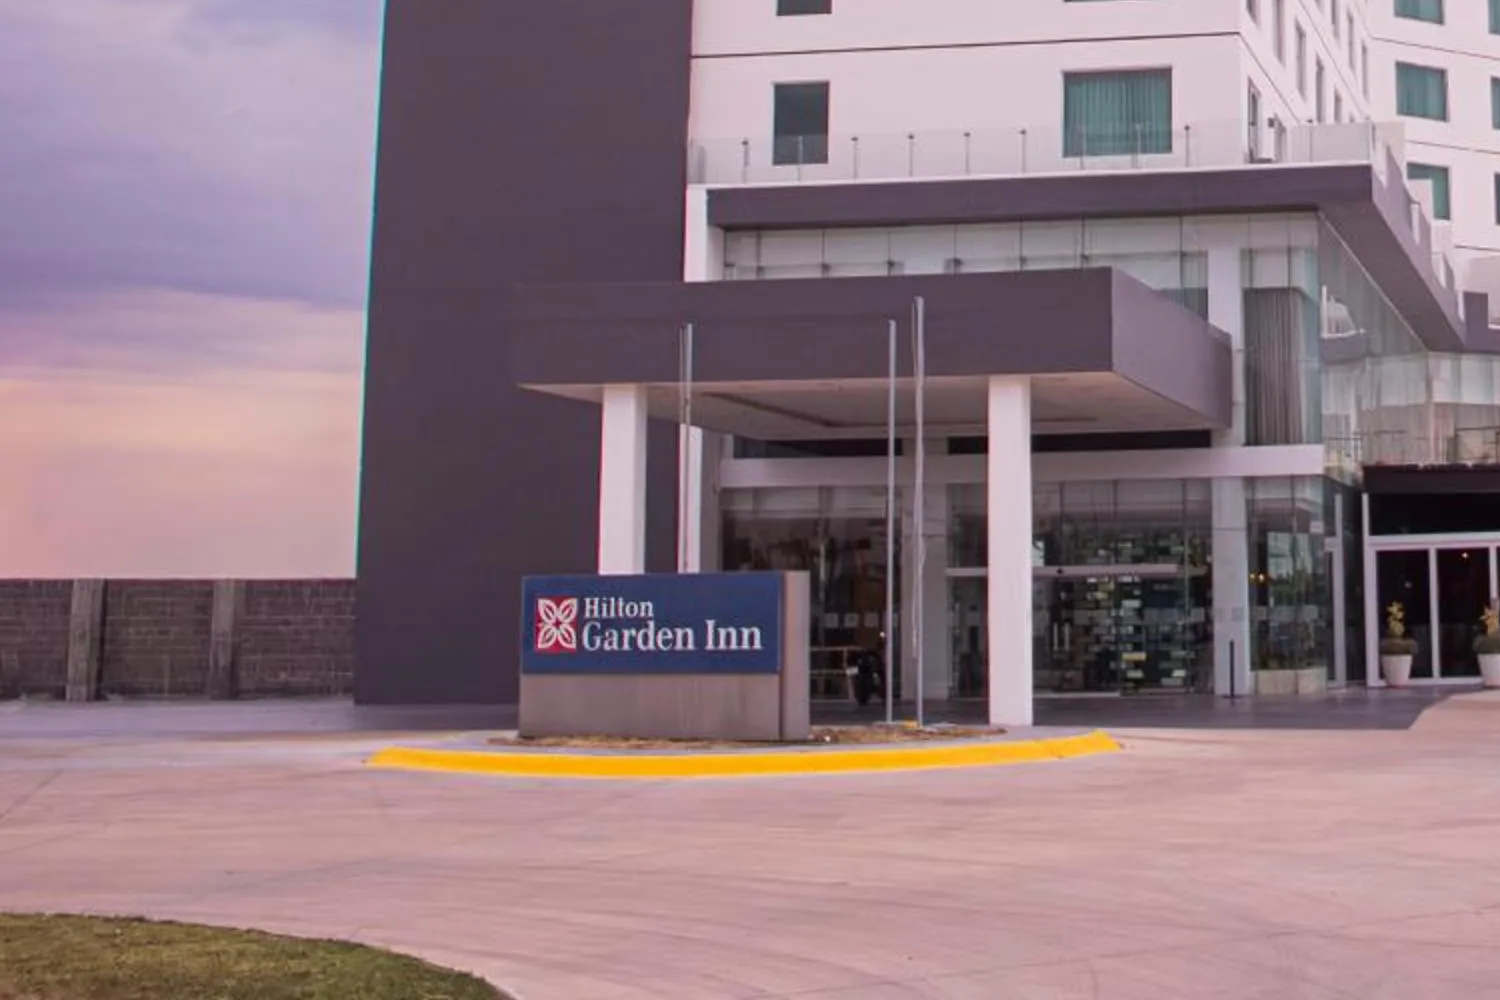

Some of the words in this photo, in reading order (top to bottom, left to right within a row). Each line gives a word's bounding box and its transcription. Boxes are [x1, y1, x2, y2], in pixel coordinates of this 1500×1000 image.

[584, 597, 654, 618] Hilton
[582, 620, 695, 651] Garden
[705, 619, 762, 650] Inn
